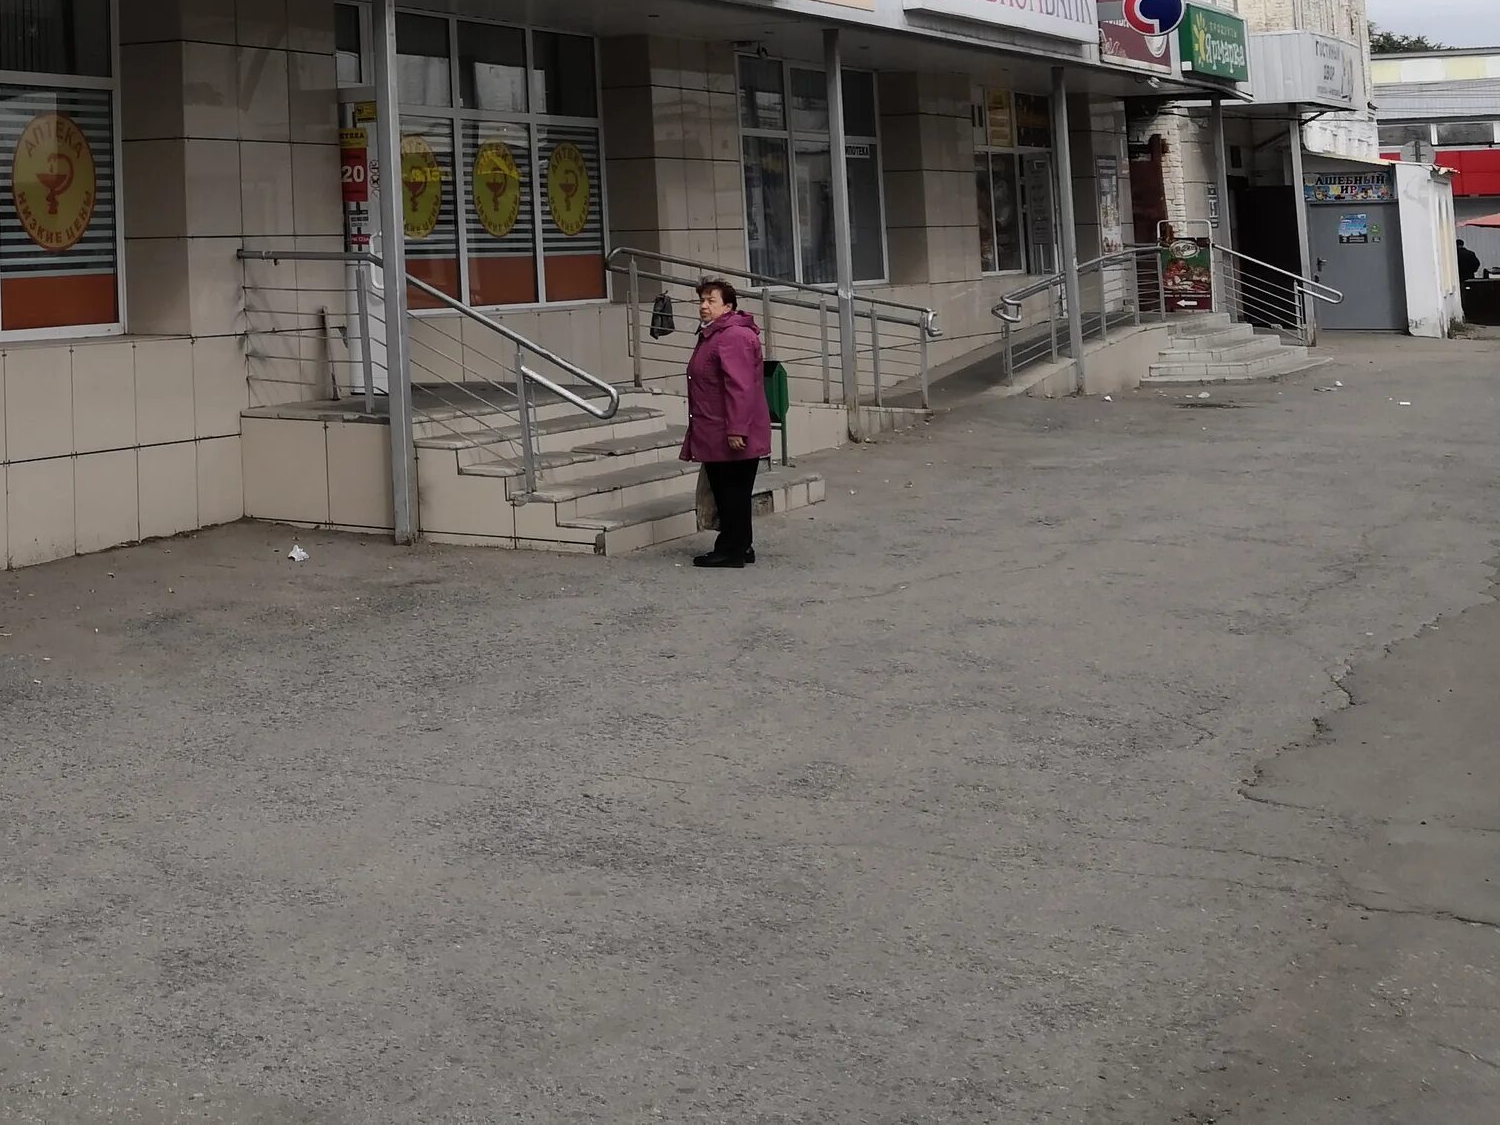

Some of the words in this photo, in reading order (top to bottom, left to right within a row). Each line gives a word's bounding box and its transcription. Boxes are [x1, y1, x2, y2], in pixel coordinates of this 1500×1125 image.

[1205, 33, 1245, 74] Ярмарка
[24, 121, 83, 158] АПТЕКА
[340, 165, 365, 183] 20
[17, 191, 63, 244] НИЗКИЕ
[65, 190, 93, 240] ЦЕНЫ
